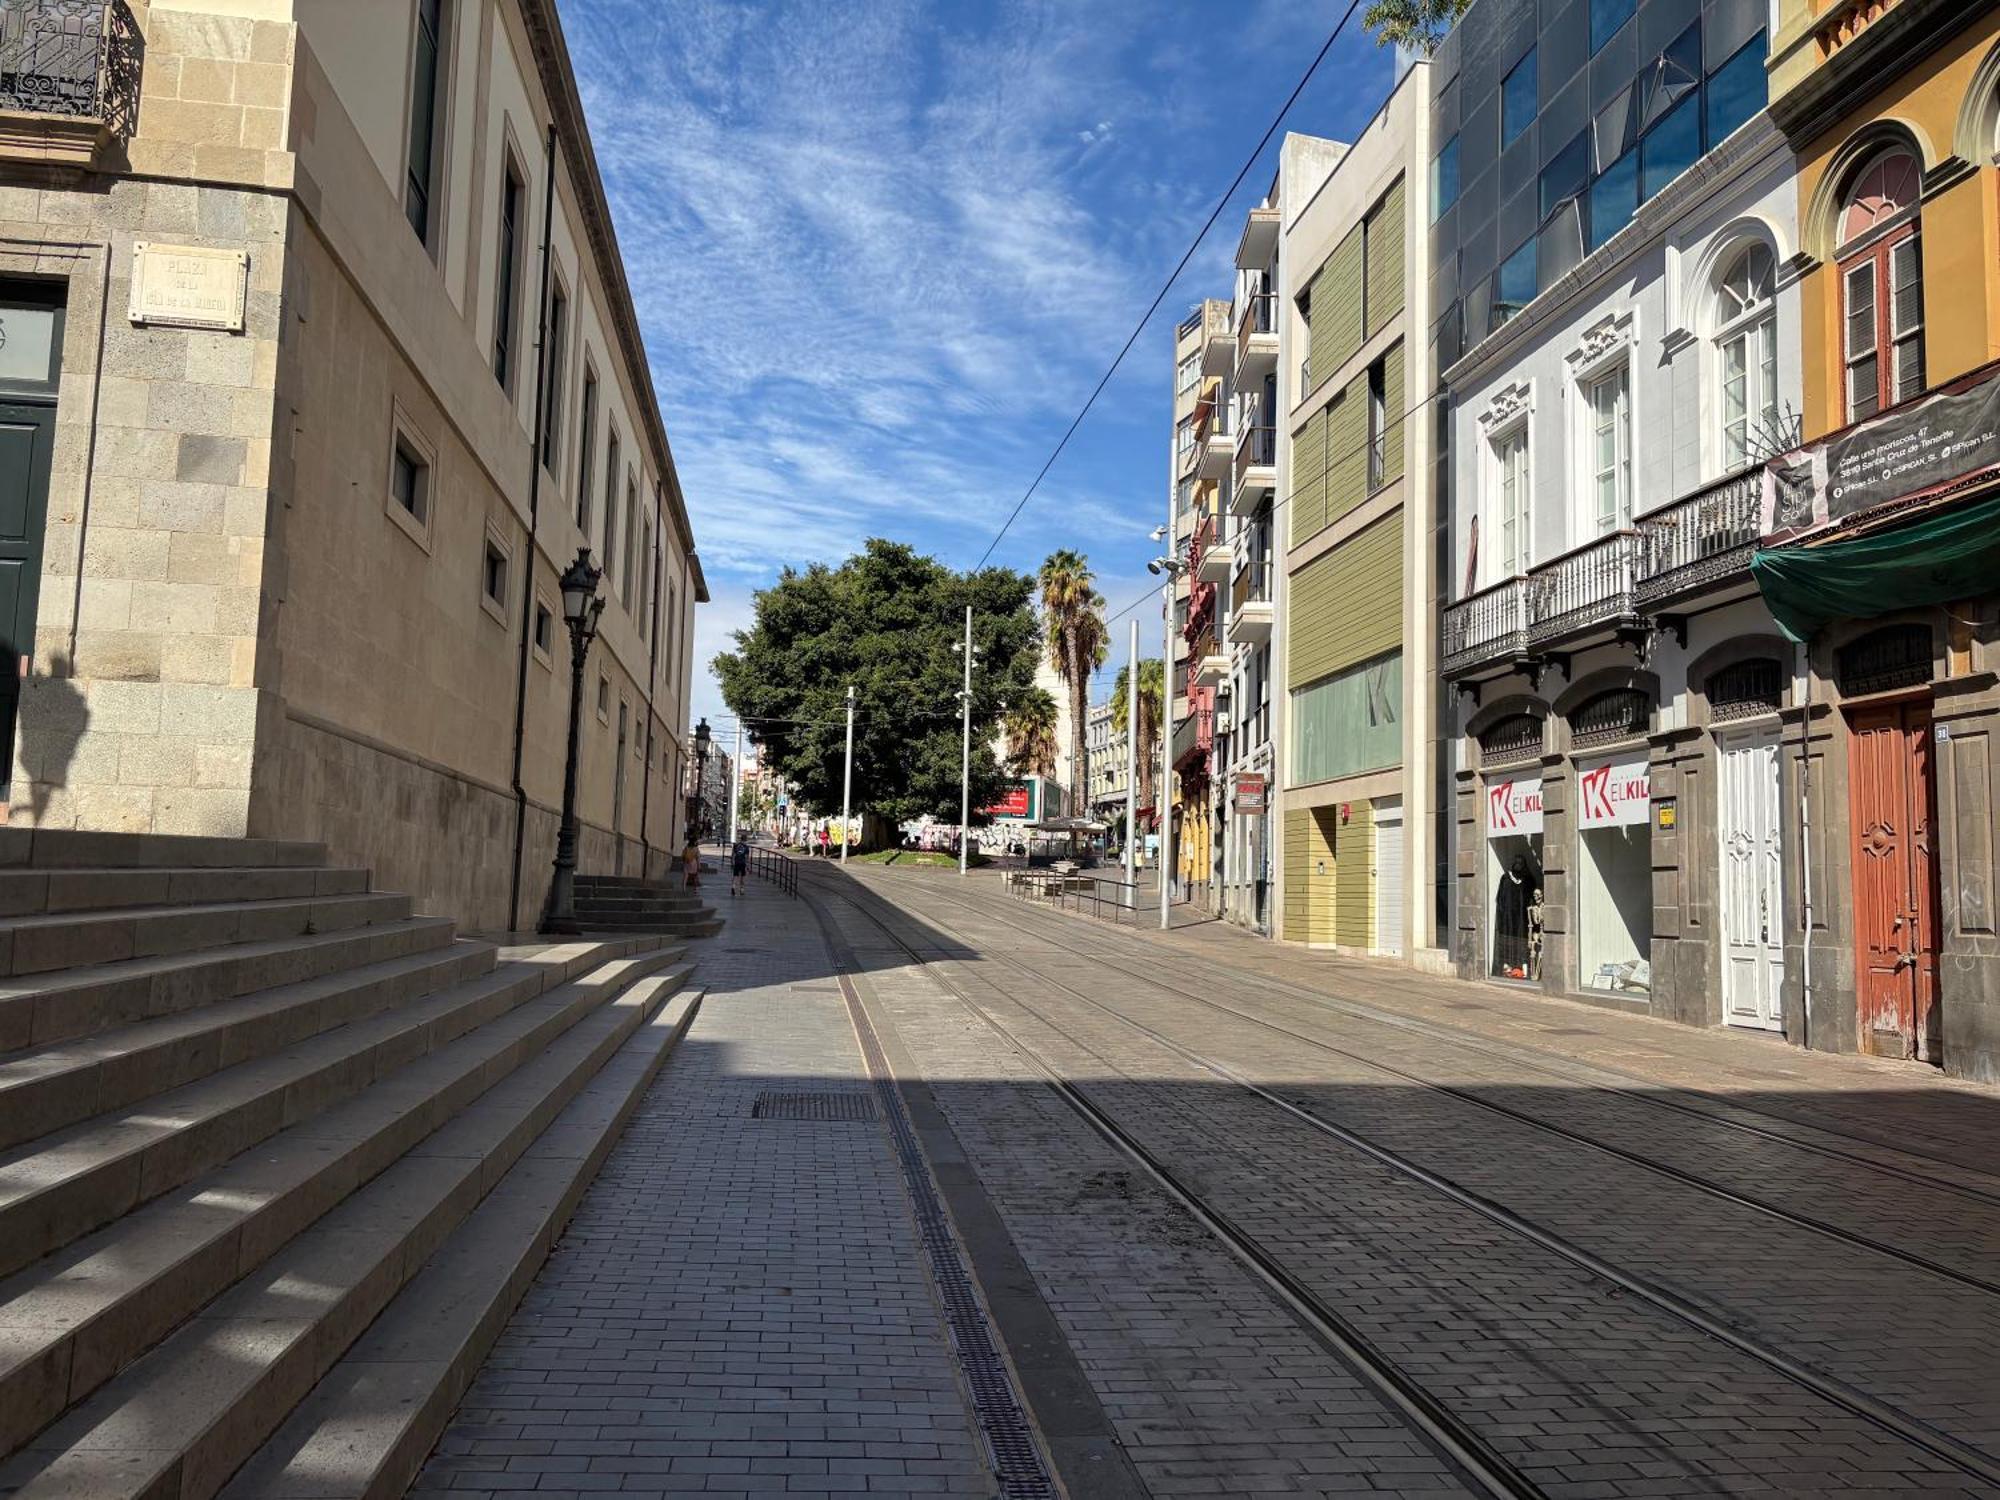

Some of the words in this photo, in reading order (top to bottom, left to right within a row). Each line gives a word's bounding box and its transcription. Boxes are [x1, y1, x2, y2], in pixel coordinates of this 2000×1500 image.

[1862, 457, 1886, 471] Santa
[1887, 449, 1907, 461] Cruz
[1907, 444, 1919, 453] de
[1512, 790, 1543, 815] ELKIL
[1611, 779, 1651, 802] ELKIL
